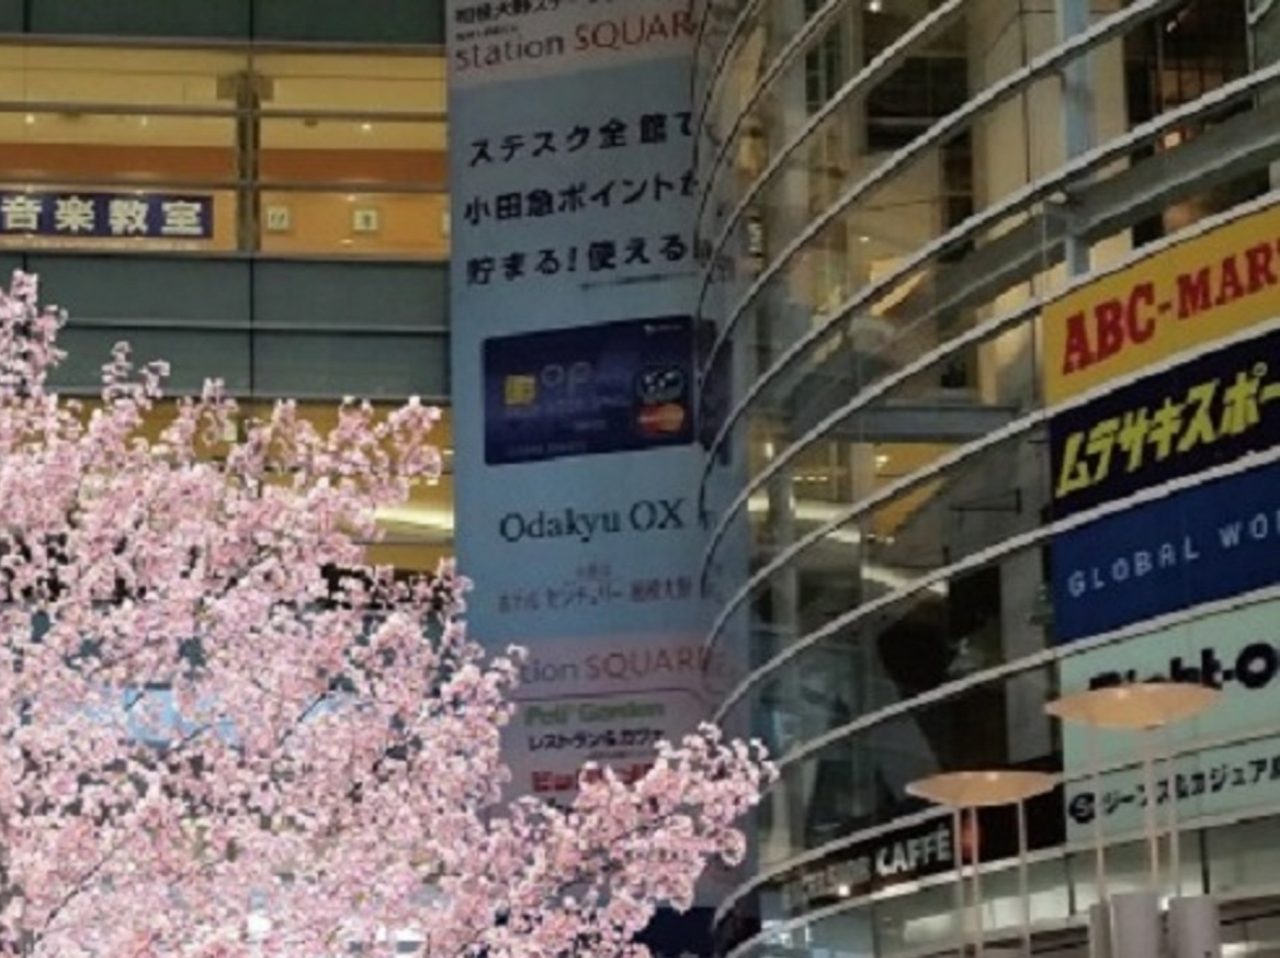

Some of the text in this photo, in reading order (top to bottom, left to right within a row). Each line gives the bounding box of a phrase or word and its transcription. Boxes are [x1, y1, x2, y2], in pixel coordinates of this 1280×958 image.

[456, 10, 697, 71] station SQUAR
[0, 195, 204, 234] 音楽教室
[1063, 237, 1280, 376] ABC-MAR
[500, 499, 685, 543] Odakyu OX
[1068, 509, 1280, 598] GLOBAL WO
